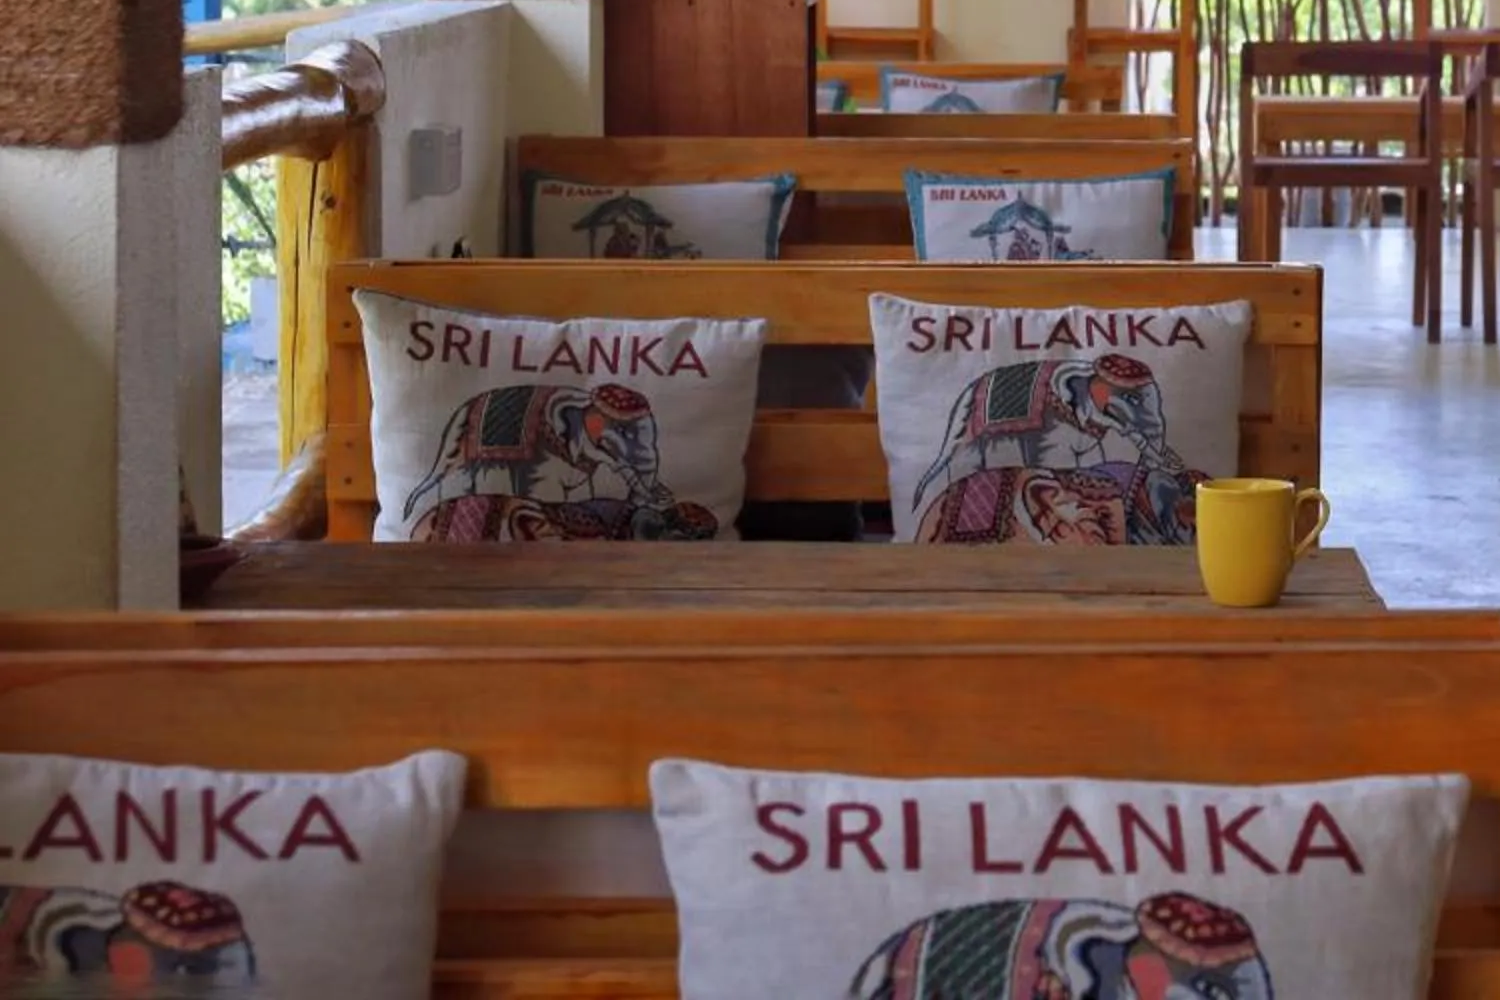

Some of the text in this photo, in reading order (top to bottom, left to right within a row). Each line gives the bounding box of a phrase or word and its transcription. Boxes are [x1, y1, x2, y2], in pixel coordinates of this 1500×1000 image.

[960, 187, 1007, 201] LANKA
[406, 320, 708, 378] SRI LANKA
[906, 313, 1206, 353] SRI LANKA
[0, 786, 362, 864] ANKA
[750, 798, 1366, 876] SRI LANKA
